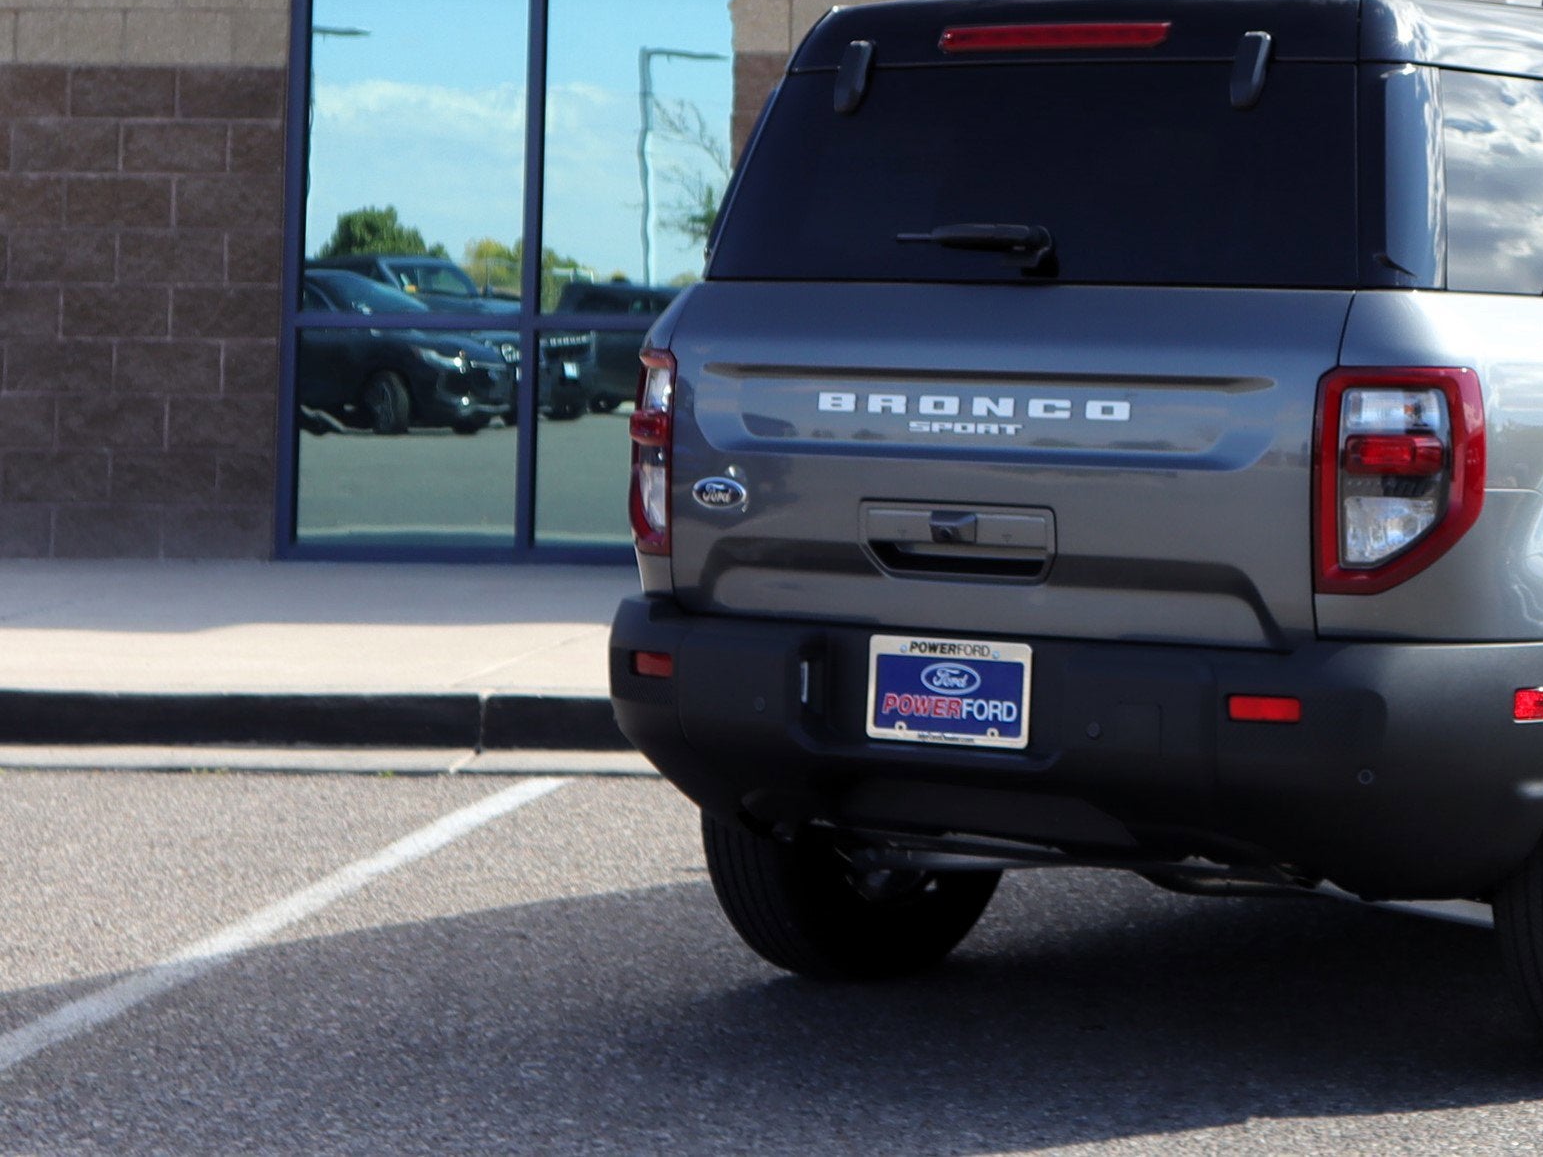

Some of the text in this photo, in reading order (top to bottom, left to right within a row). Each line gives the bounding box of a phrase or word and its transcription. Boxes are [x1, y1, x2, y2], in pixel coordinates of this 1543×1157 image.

[817, 391, 1131, 421] BRONCO
[908, 420, 1023, 436] SPORT
[702, 482, 733, 503] Ford
[909, 640, 991, 657] POWERFORD
[932, 667, 970, 688] Ford
[881, 692, 1018, 722] POWERFORD
